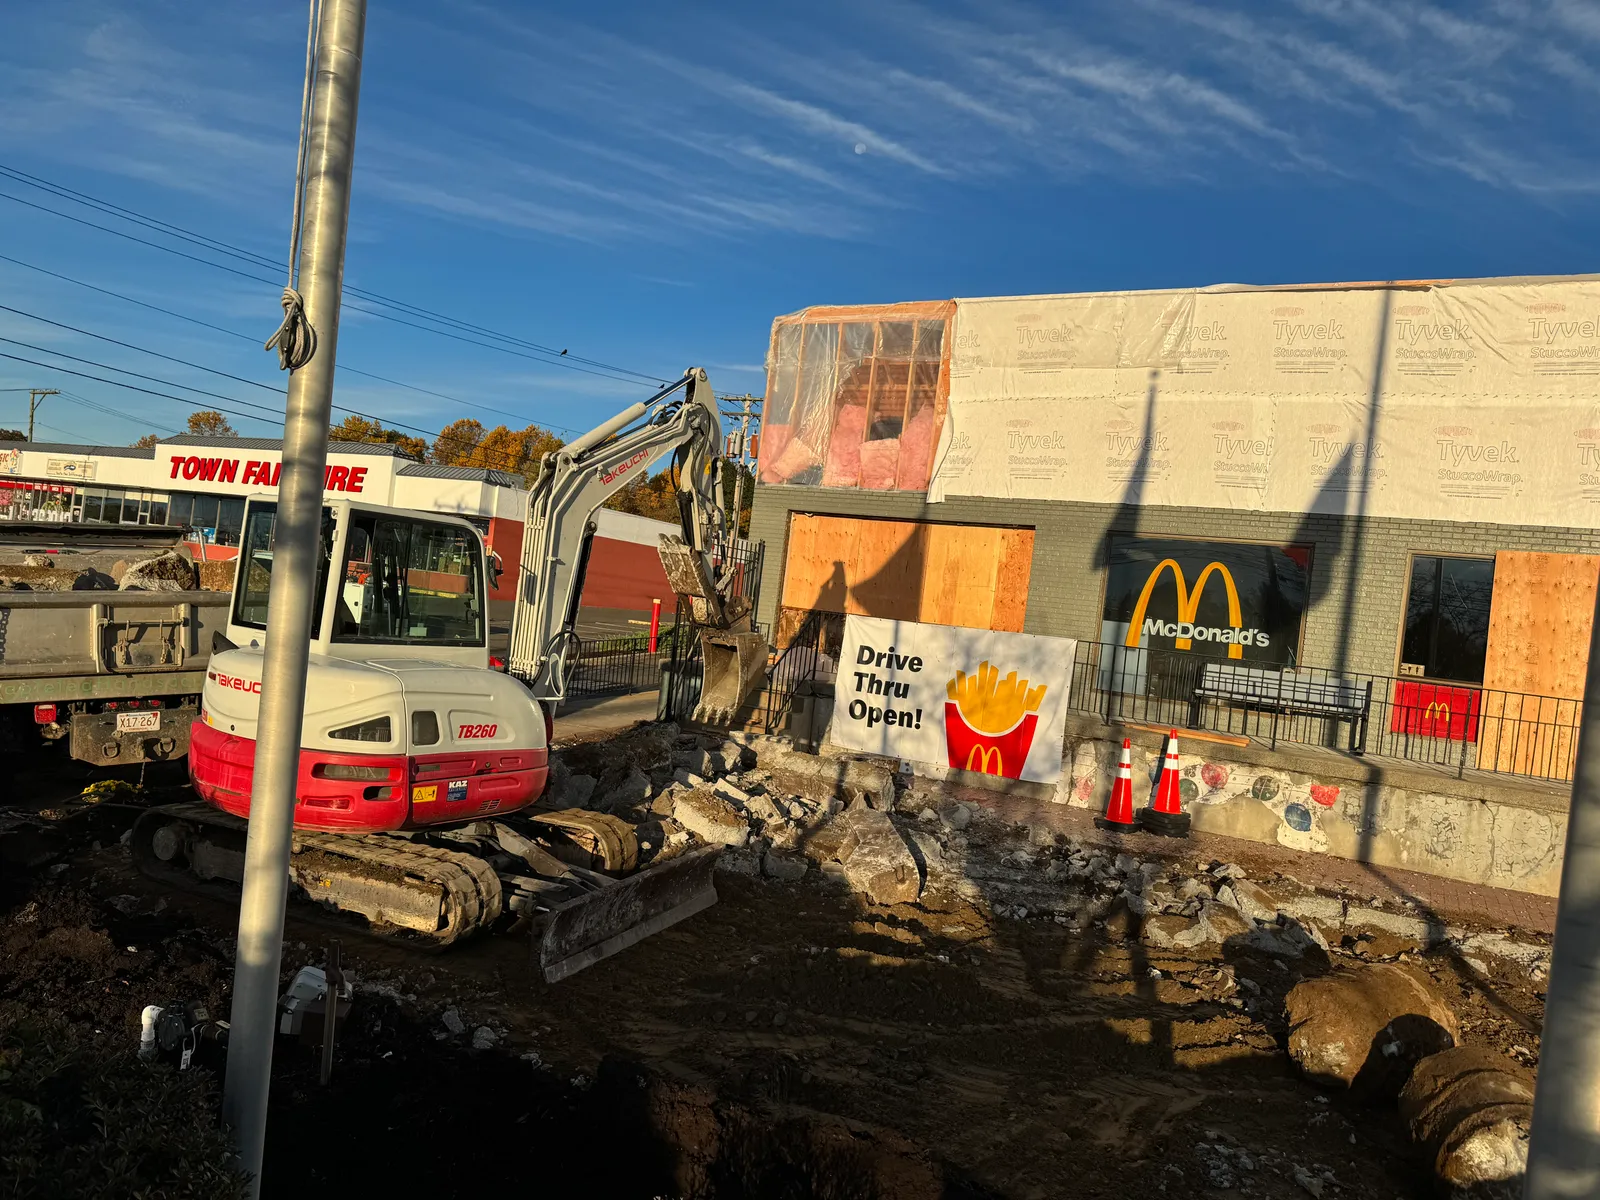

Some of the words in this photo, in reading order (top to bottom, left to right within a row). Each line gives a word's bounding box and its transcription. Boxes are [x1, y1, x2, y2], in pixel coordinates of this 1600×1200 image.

[1528, 315, 1600, 344] Tyve
[170, 456, 239, 483] TOWN
[242, 460, 282, 487] FAI
[323, 465, 368, 493] IRE
[1142, 618, 1270, 647] McDonald's
[856, 644, 923, 673] Drive
[853, 671, 910, 699] Thru
[848, 699, 923, 730] Open!
[458, 724, 498, 738] TB260
[449, 780, 467, 788] KAZ
